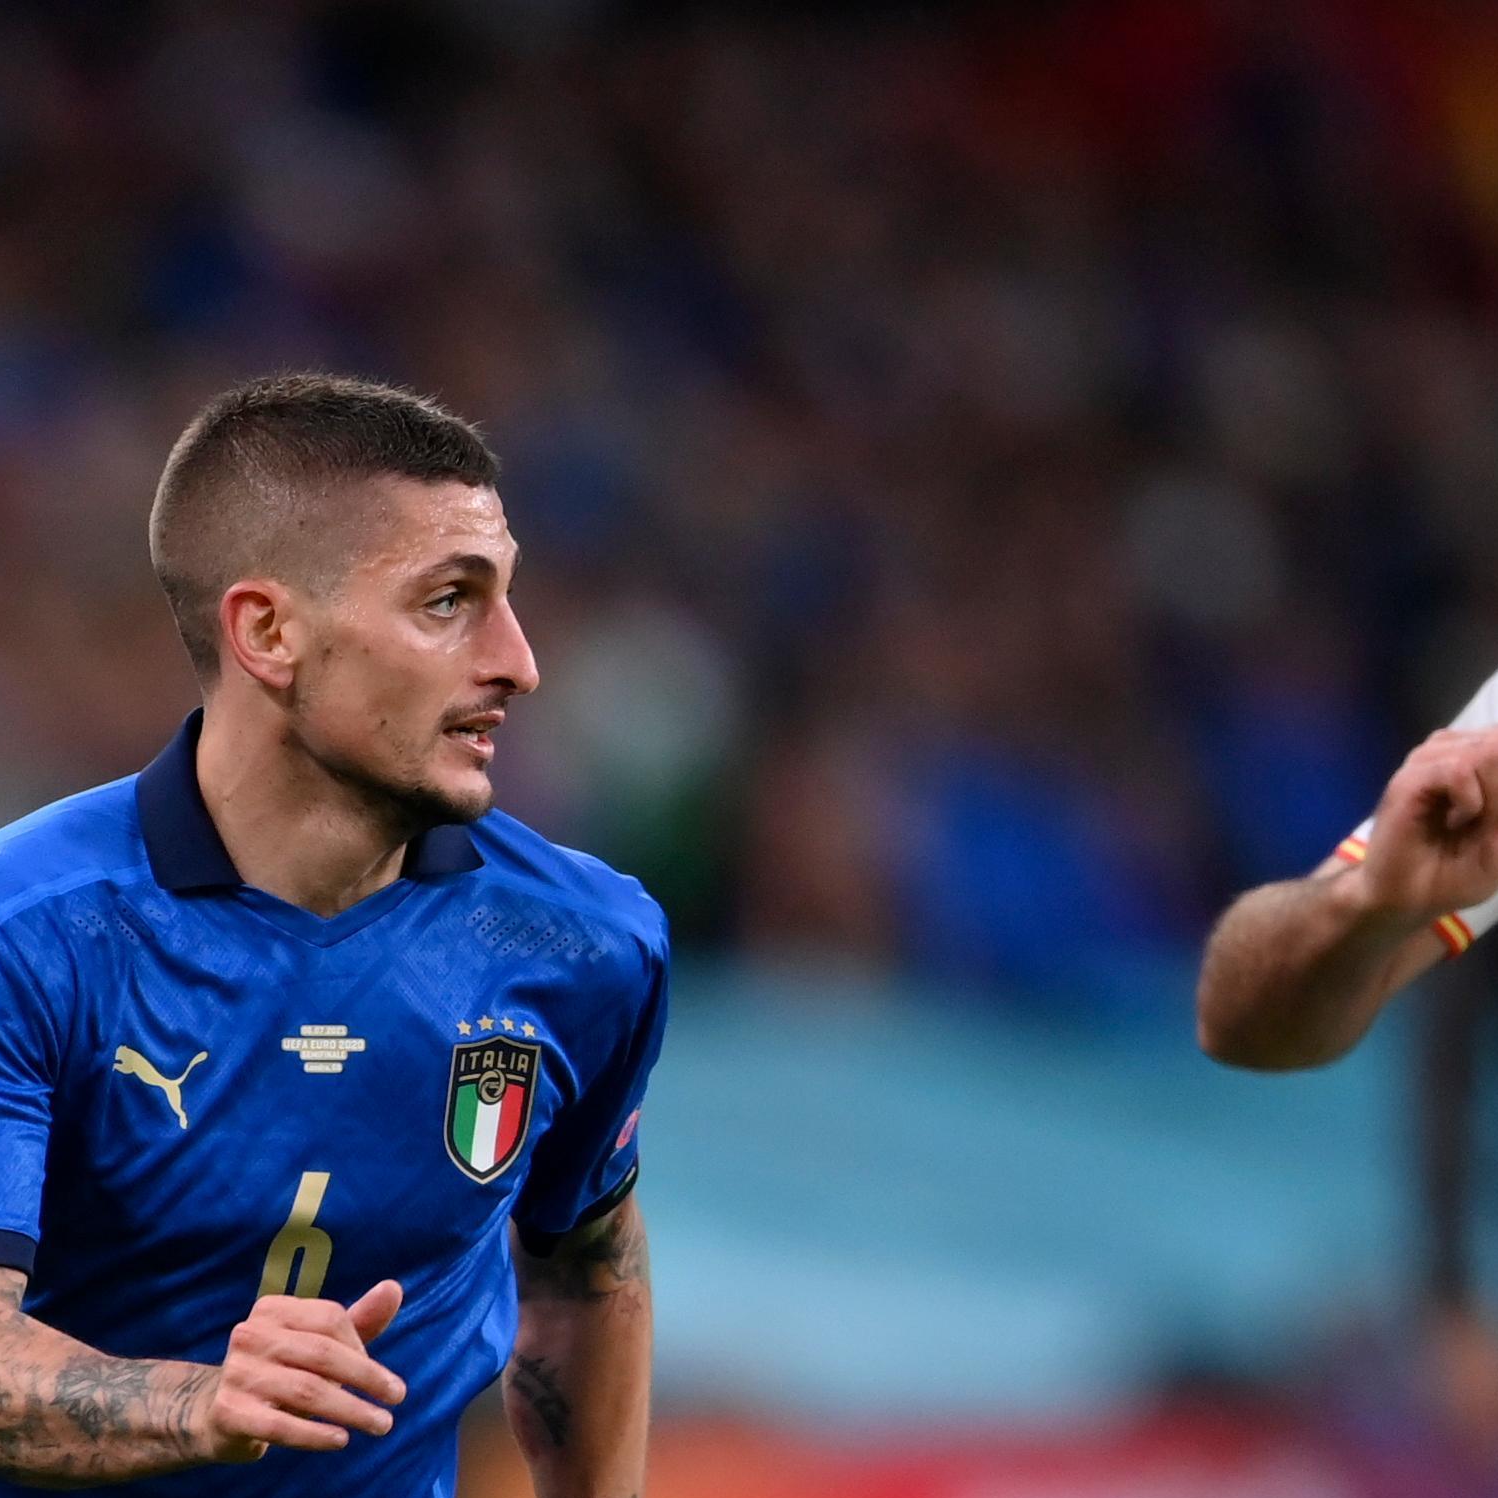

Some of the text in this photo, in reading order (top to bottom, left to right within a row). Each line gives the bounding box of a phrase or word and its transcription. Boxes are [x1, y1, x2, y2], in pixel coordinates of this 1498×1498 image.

[283, 1039, 365, 1050] UEFA EURO 2020
[460, 1050, 530, 1073] ITALIA
[257, 1171, 333, 1299] 6
